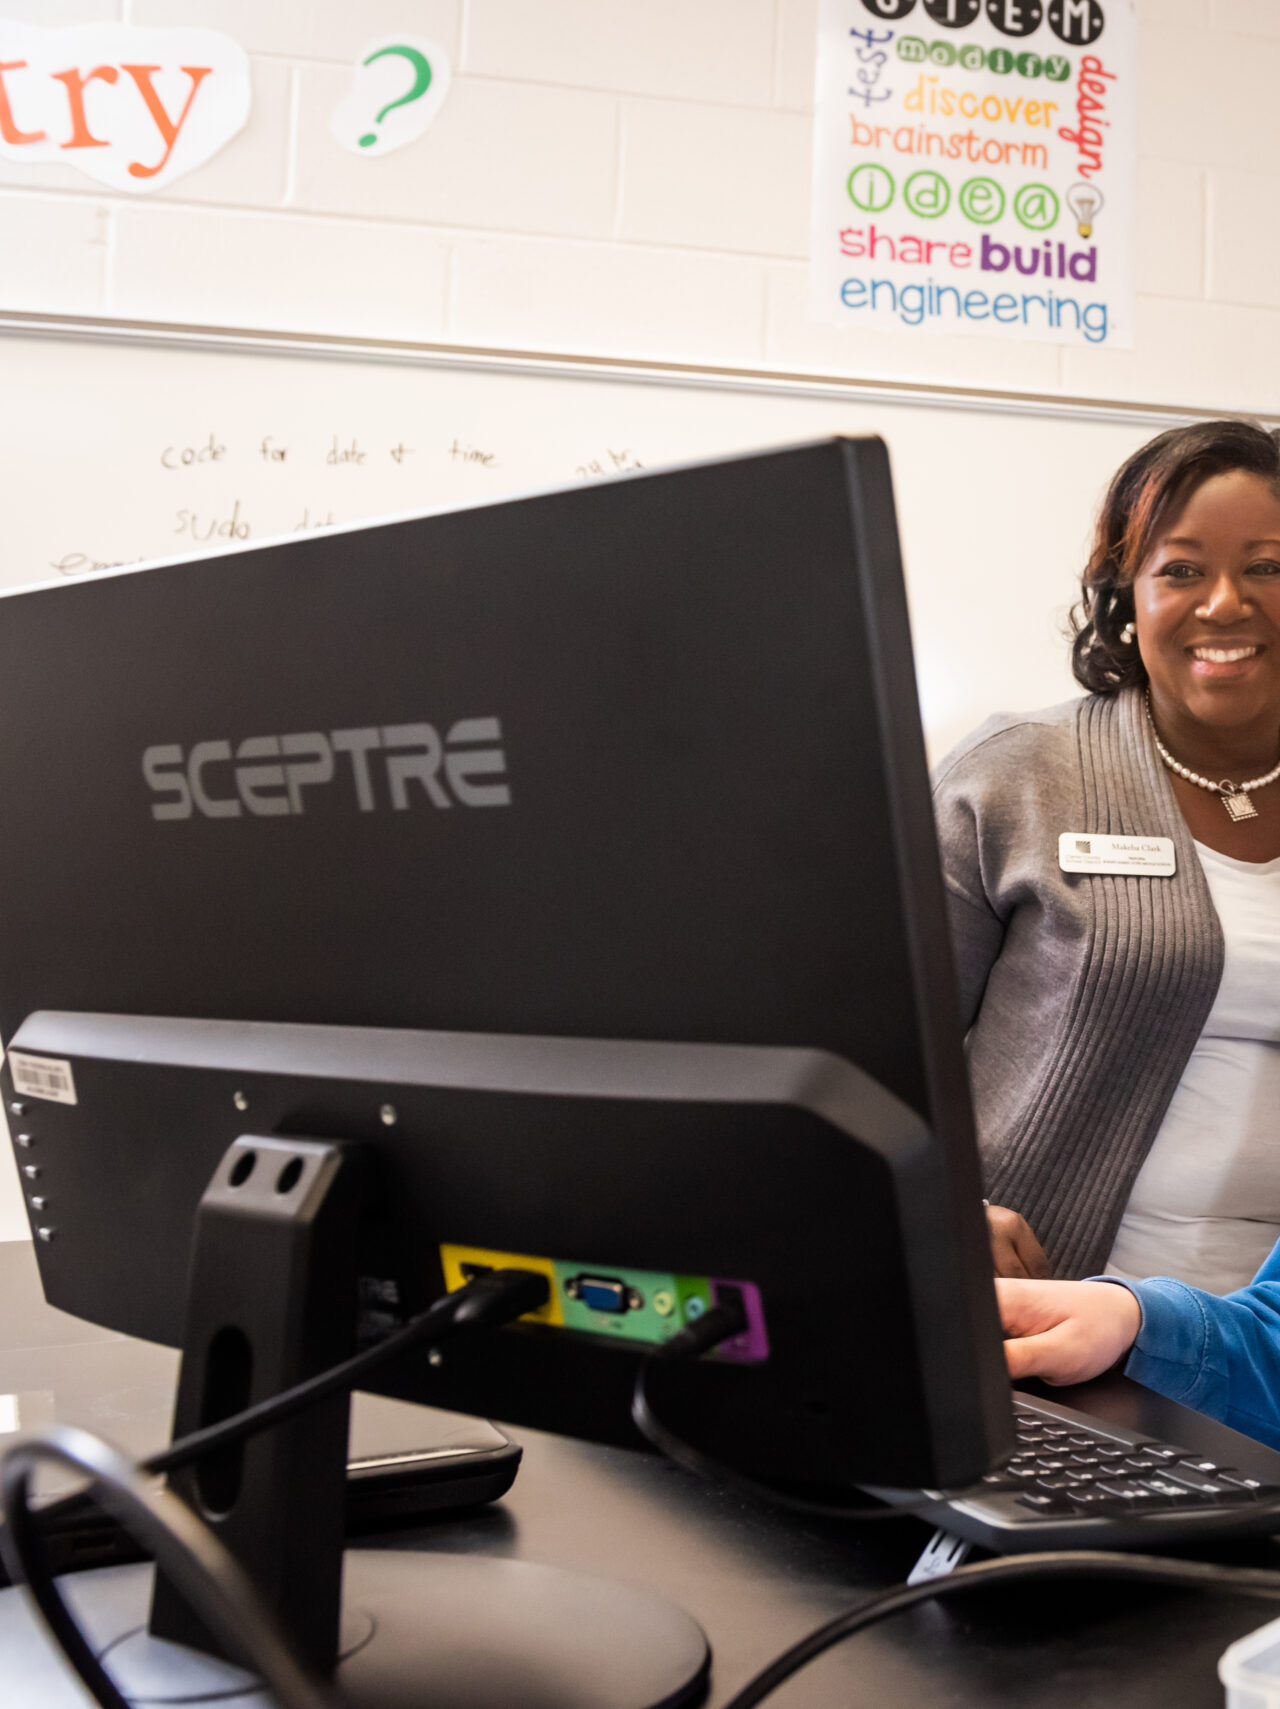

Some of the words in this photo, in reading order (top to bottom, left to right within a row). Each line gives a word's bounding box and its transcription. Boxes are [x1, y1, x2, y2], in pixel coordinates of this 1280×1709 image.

[848, 26, 895, 108] test
[897, 36, 1070, 82] modify
[903, 73, 1059, 129] discover
[1058, 55, 1117, 179] design
[850, 113, 1049, 170] brainstorm
[850, 164, 1057, 229] idea
[839, 225, 973, 269] share
[980, 234, 1098, 283] build
[840, 278, 1108, 343] engineering
[160, 432, 228, 470] code
[260, 435, 287, 461] for
[326, 432, 367, 465] date
[448, 438, 500, 468] time
[173, 499, 250, 541] sudo
[142, 716, 512, 821] SCEPTRE
